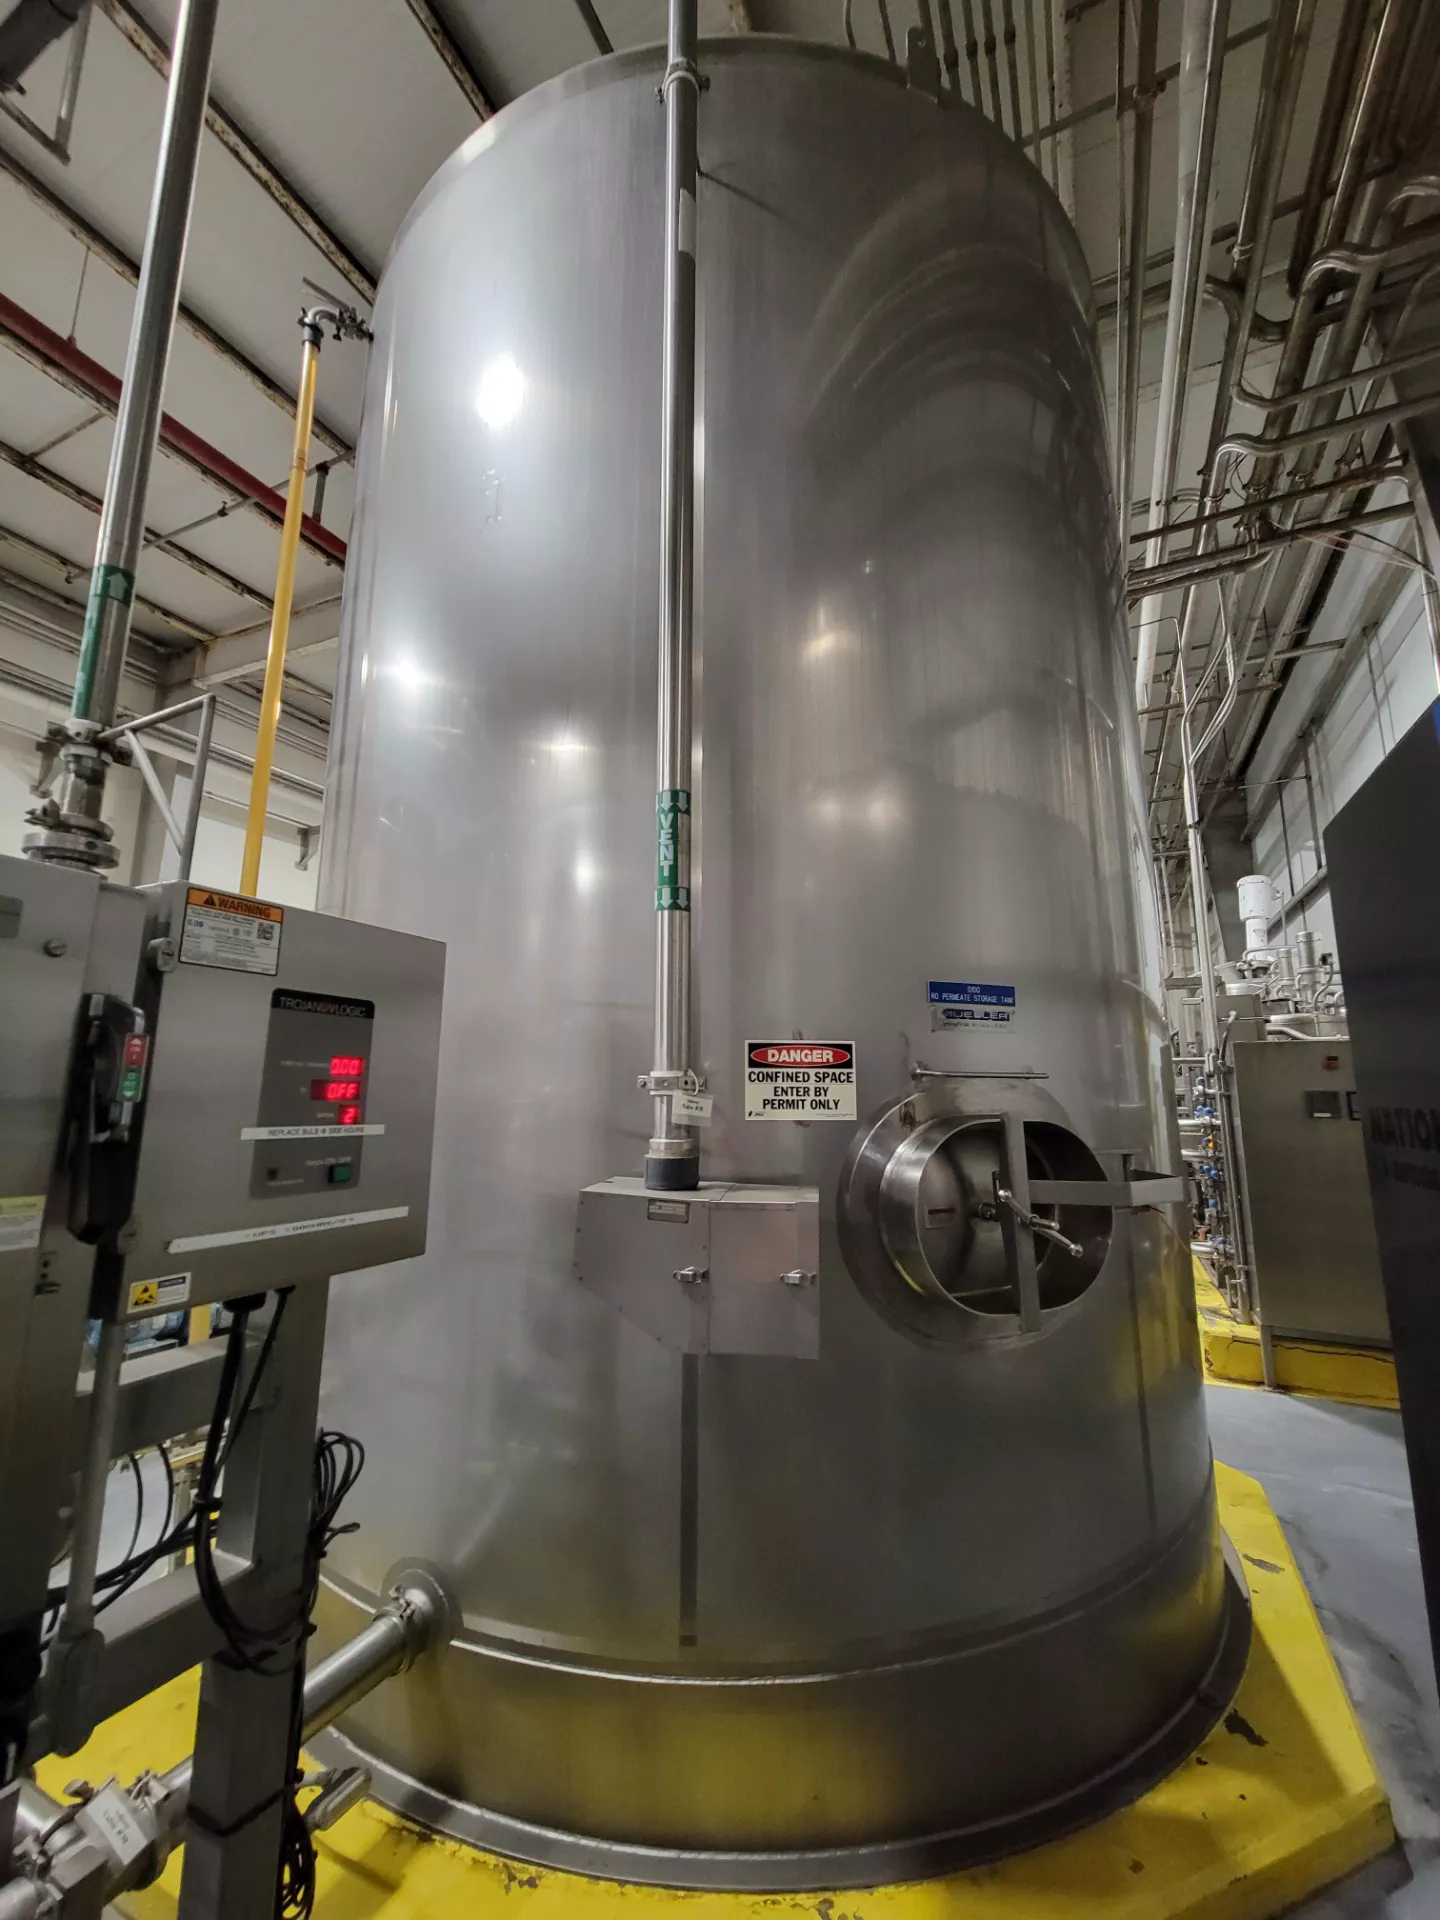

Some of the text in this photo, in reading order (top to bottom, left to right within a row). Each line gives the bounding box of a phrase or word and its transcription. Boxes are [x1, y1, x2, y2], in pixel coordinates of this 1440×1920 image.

[660, 812, 674, 877] VENT
[217, 897, 271, 918] WARNING
[931, 992, 1014, 1004] RO PERMEATE STORAGE TANK
[943, 1008, 1009, 1021] MUELLER
[767, 1049, 834, 1063] DANGER
[748, 1071, 854, 1084] CONFINED SPACE
[327, 1083, 357, 1099] OFF
[773, 1086, 829, 1097] ENTER BY
[763, 1099, 841, 1110] PERMIT ONLY
[344, 1107, 355, 1123] 2
